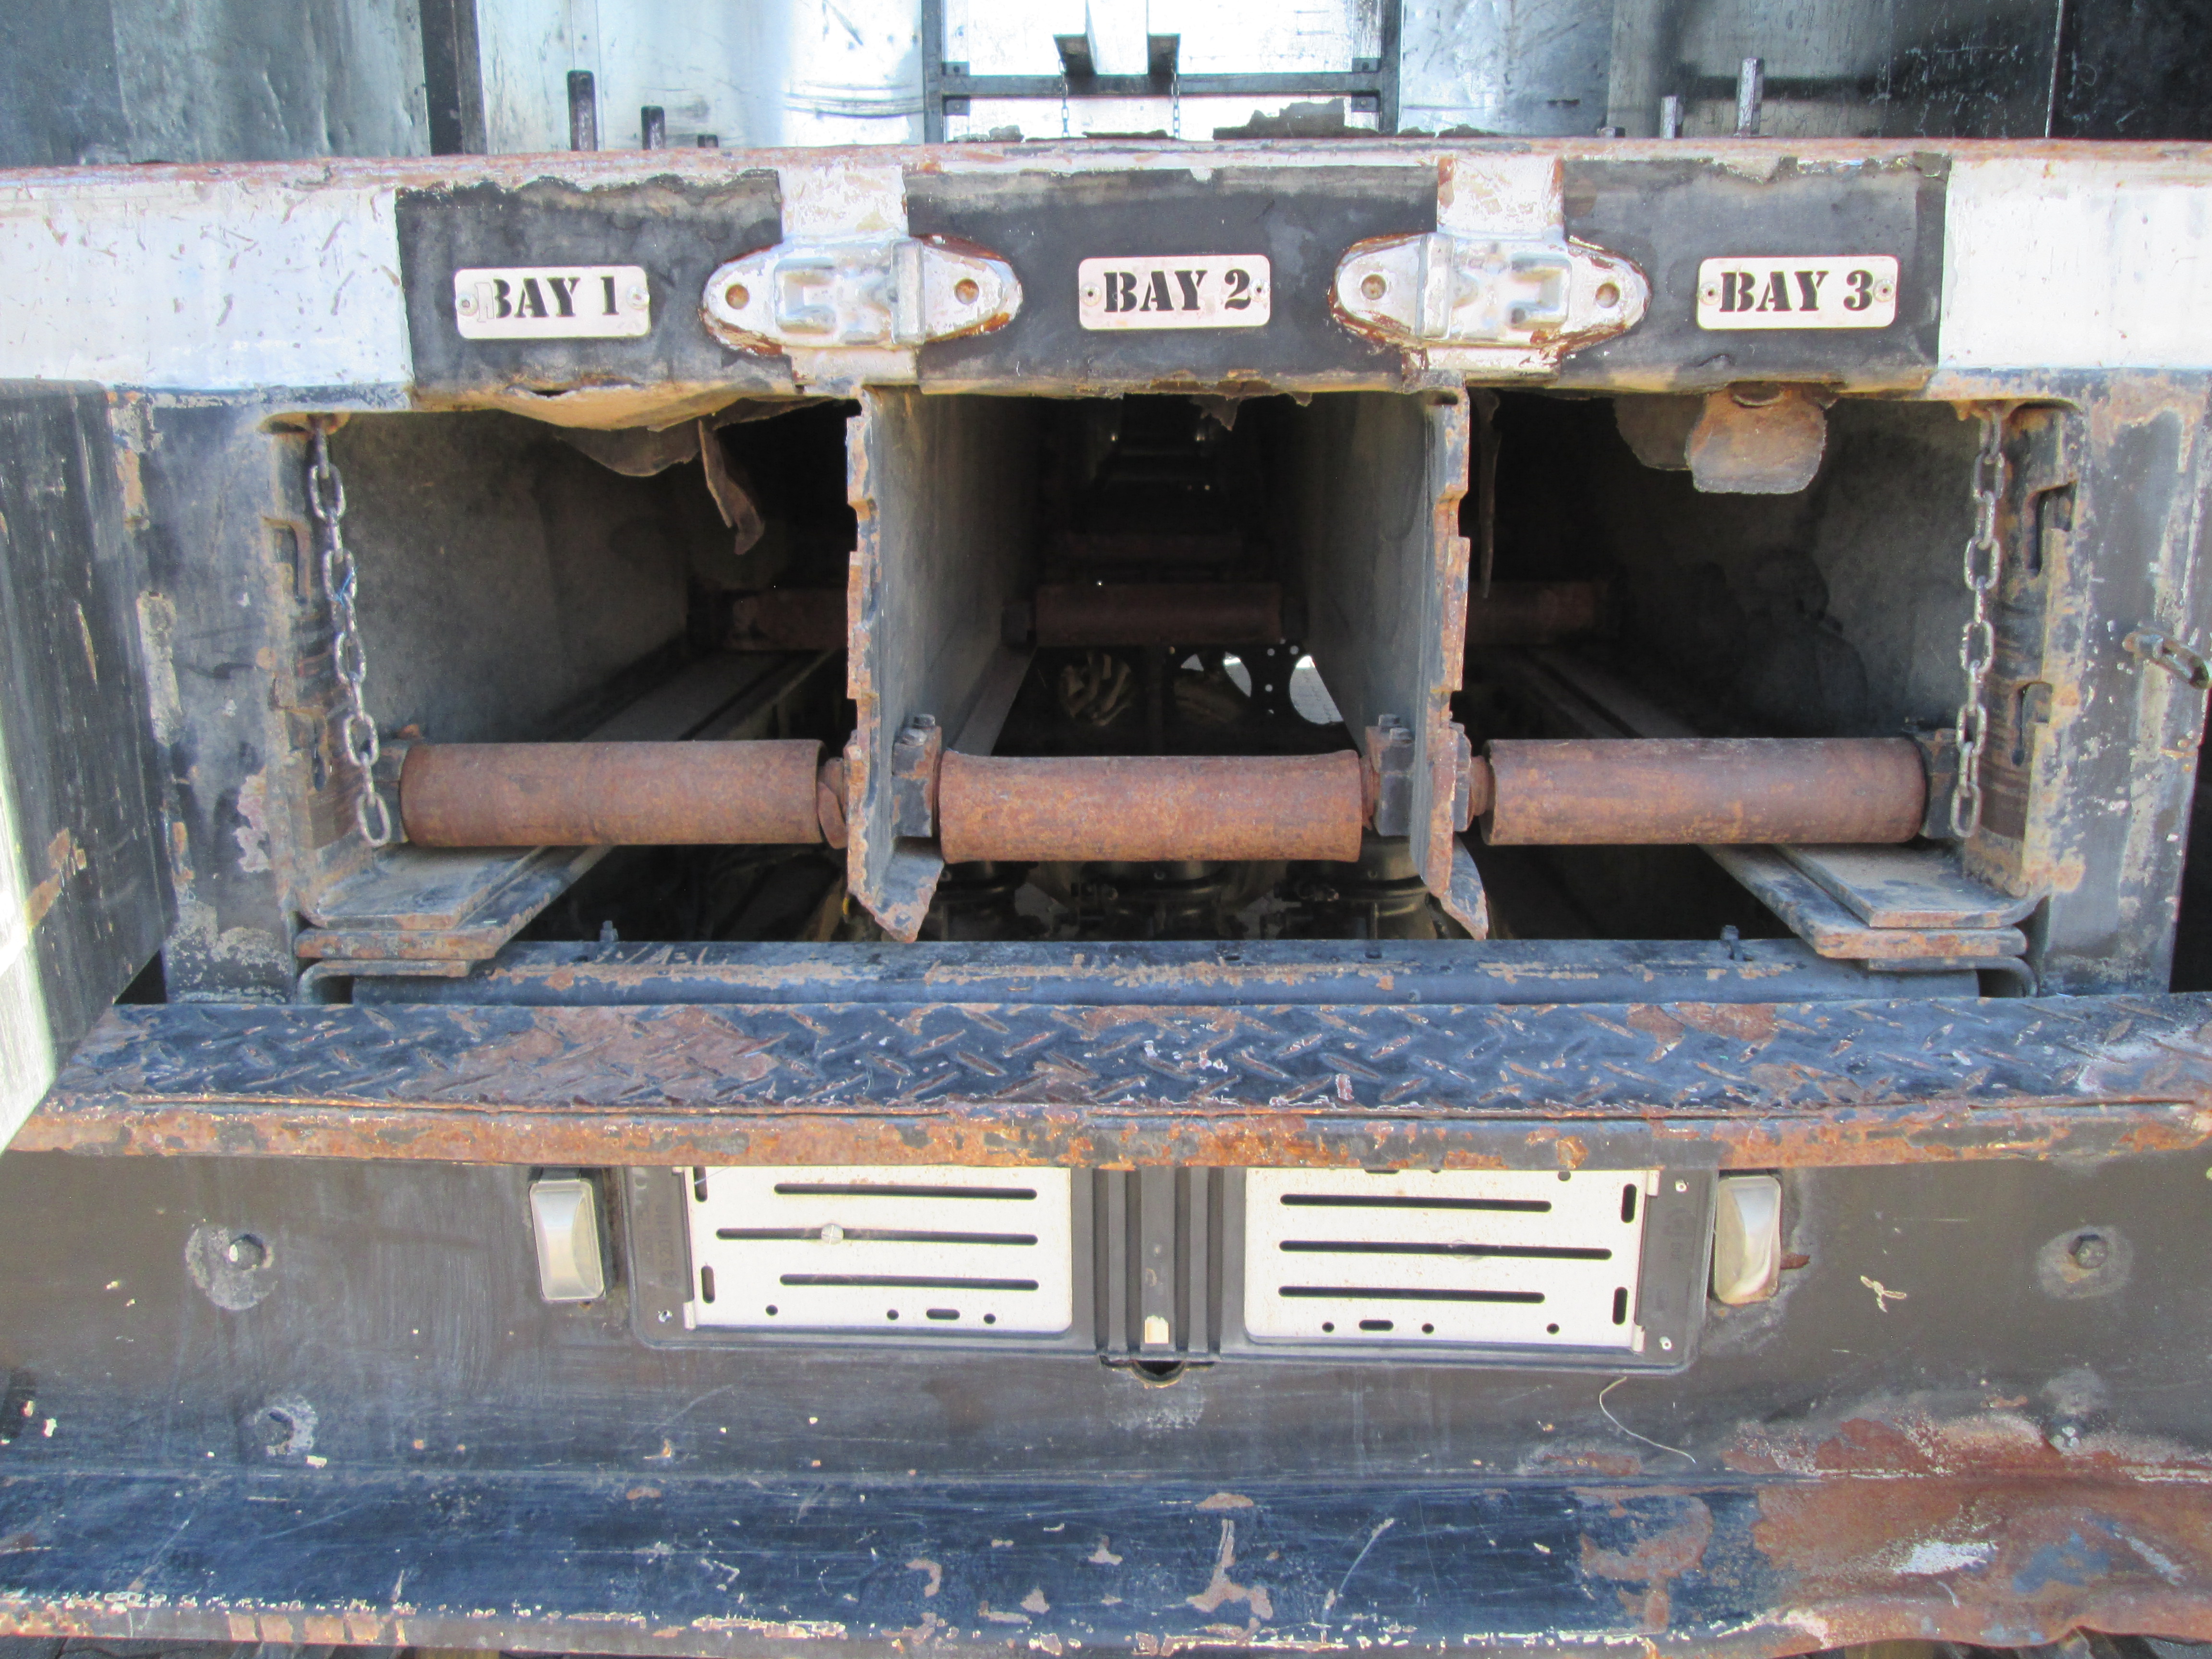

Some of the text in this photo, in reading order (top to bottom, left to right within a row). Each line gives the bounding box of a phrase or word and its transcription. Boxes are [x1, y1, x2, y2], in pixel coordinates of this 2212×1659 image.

[475, 275, 620, 322] BAY 1
[1104, 268, 1251, 312] BAY 2
[1719, 269, 1873, 312] BAY 3
